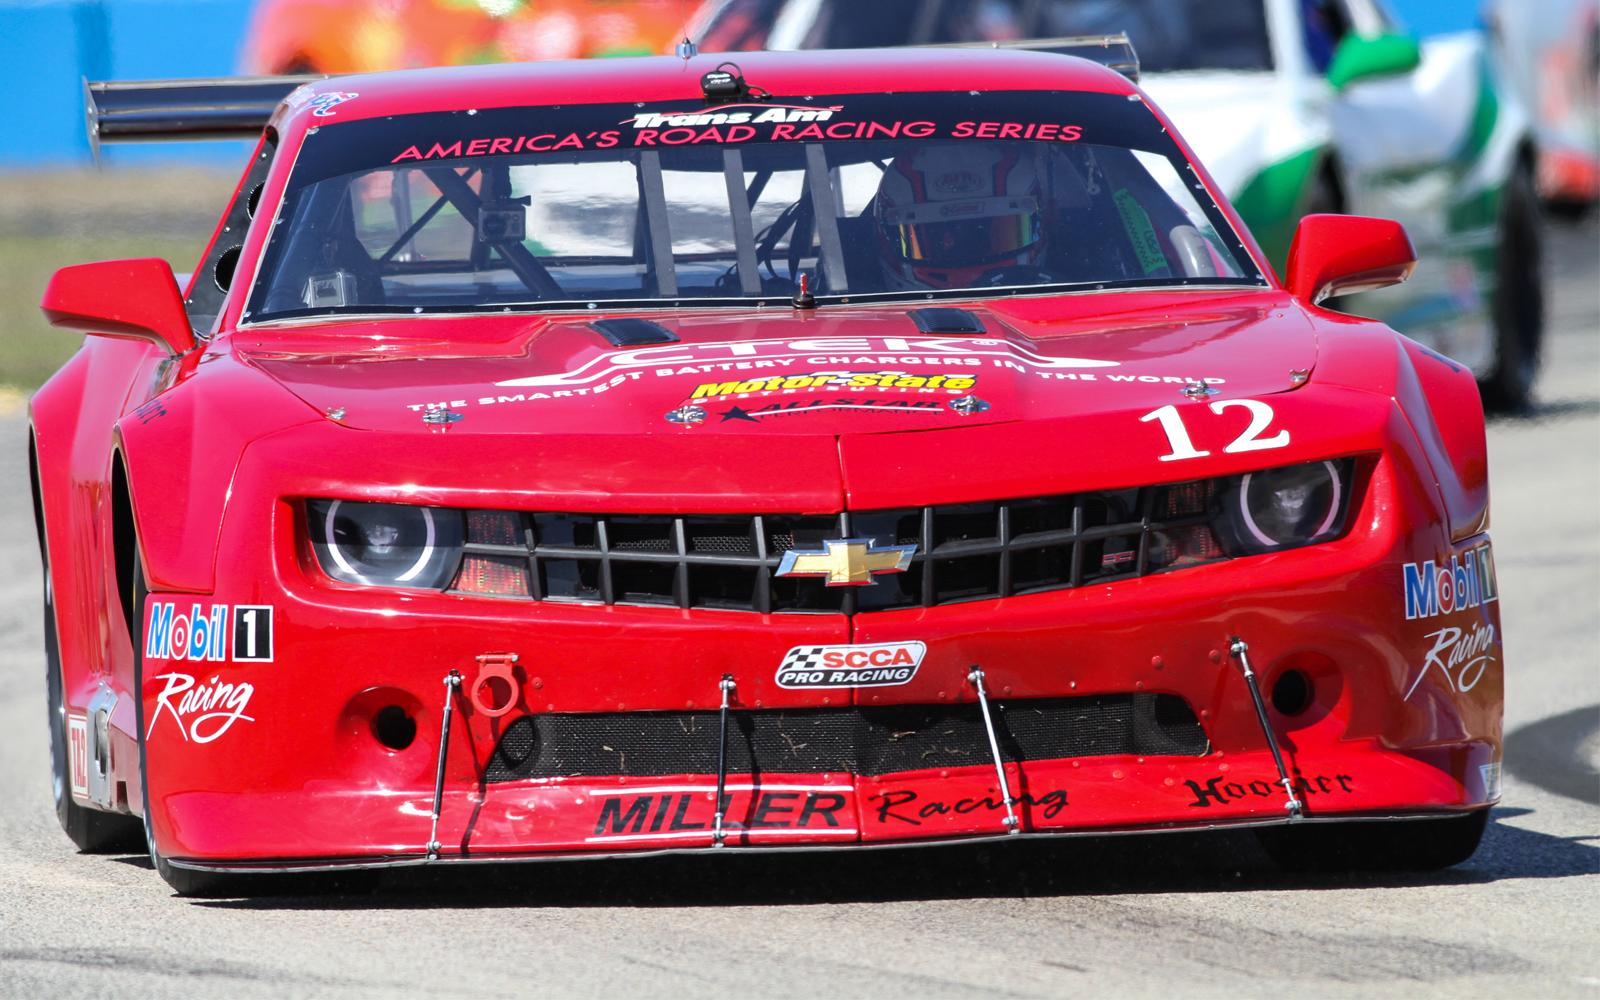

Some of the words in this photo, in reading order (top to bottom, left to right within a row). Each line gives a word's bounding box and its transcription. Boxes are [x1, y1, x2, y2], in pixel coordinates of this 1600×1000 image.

[390, 130, 621, 164] AMERICA'S
[633, 125, 756, 147] ROAD
[770, 121, 937, 141] RACING
[950, 121, 1083, 142] SERIES
[632, 112, 746, 129] Trans
[753, 107, 833, 124] Am
[609, 338, 975, 365] CTEK
[406, 399, 468, 412] THE
[477, 370, 644, 406] SMARTEST
[655, 358, 796, 378] BATTERY
[806, 356, 983, 367] CHARGERS
[993, 359, 1026, 374] IN
[1035, 371, 1098, 383] THE
[1106, 374, 1226, 385] WORLD
[1138, 398, 1291, 463] 12
[1403, 550, 1480, 620] Mobil
[145, 601, 229, 662] Mobil
[781, 671, 825, 684] PRO
[828, 668, 910, 683] RACING
[823, 648, 914, 669] SCCA
[1403, 620, 1496, 702] Racing
[146, 671, 256, 744] Racing
[594, 792, 847, 835] MILLER
